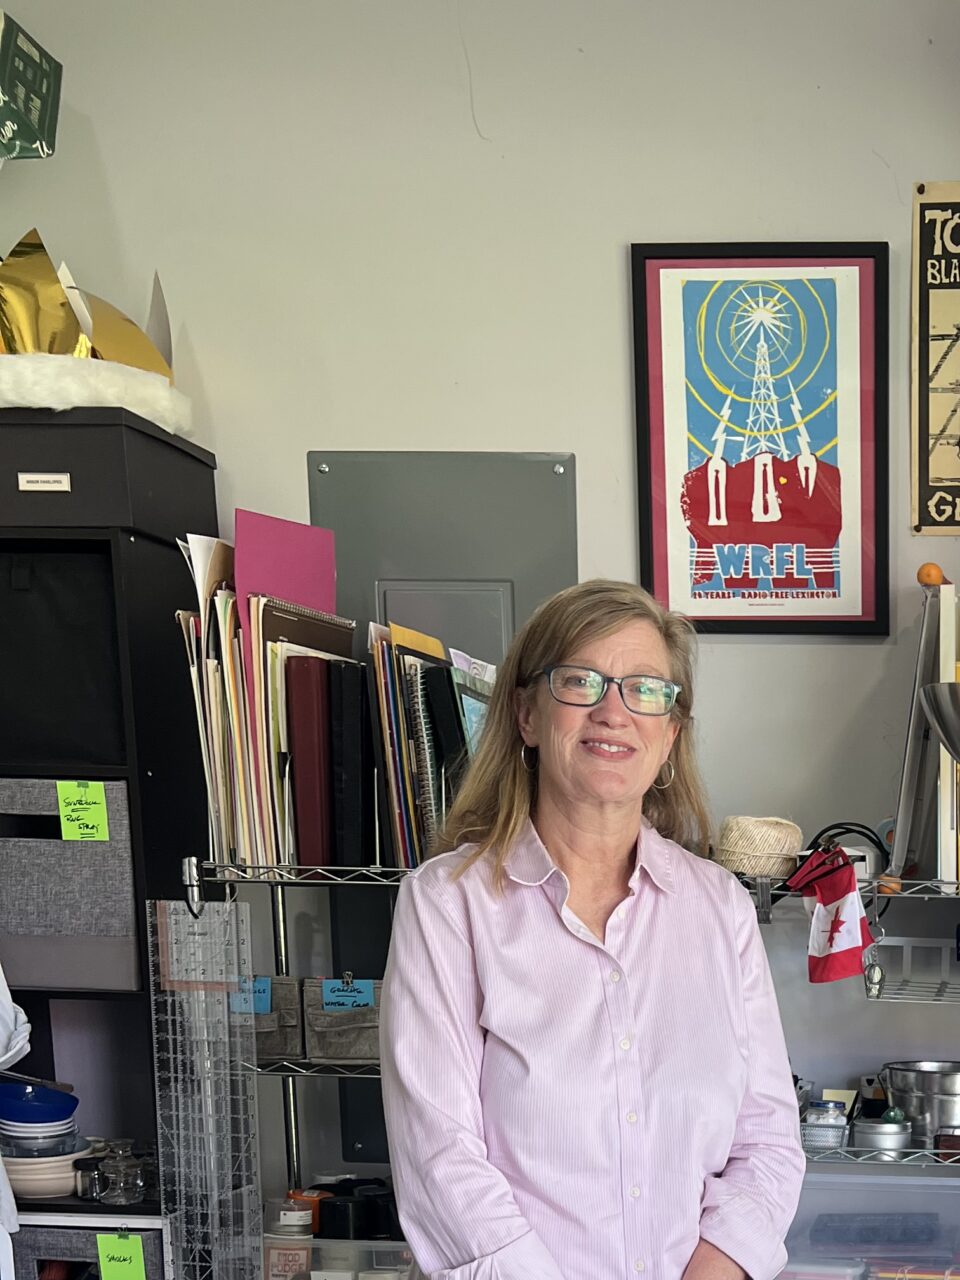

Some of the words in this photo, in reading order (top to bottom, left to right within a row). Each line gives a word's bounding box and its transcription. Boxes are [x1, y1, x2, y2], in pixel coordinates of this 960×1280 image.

[713, 543, 814, 578] WRFL
[740, 591, 768, 599] RADIO
[770, 591, 789, 599] FREE
[791, 591, 838, 600] LEXINGTON
